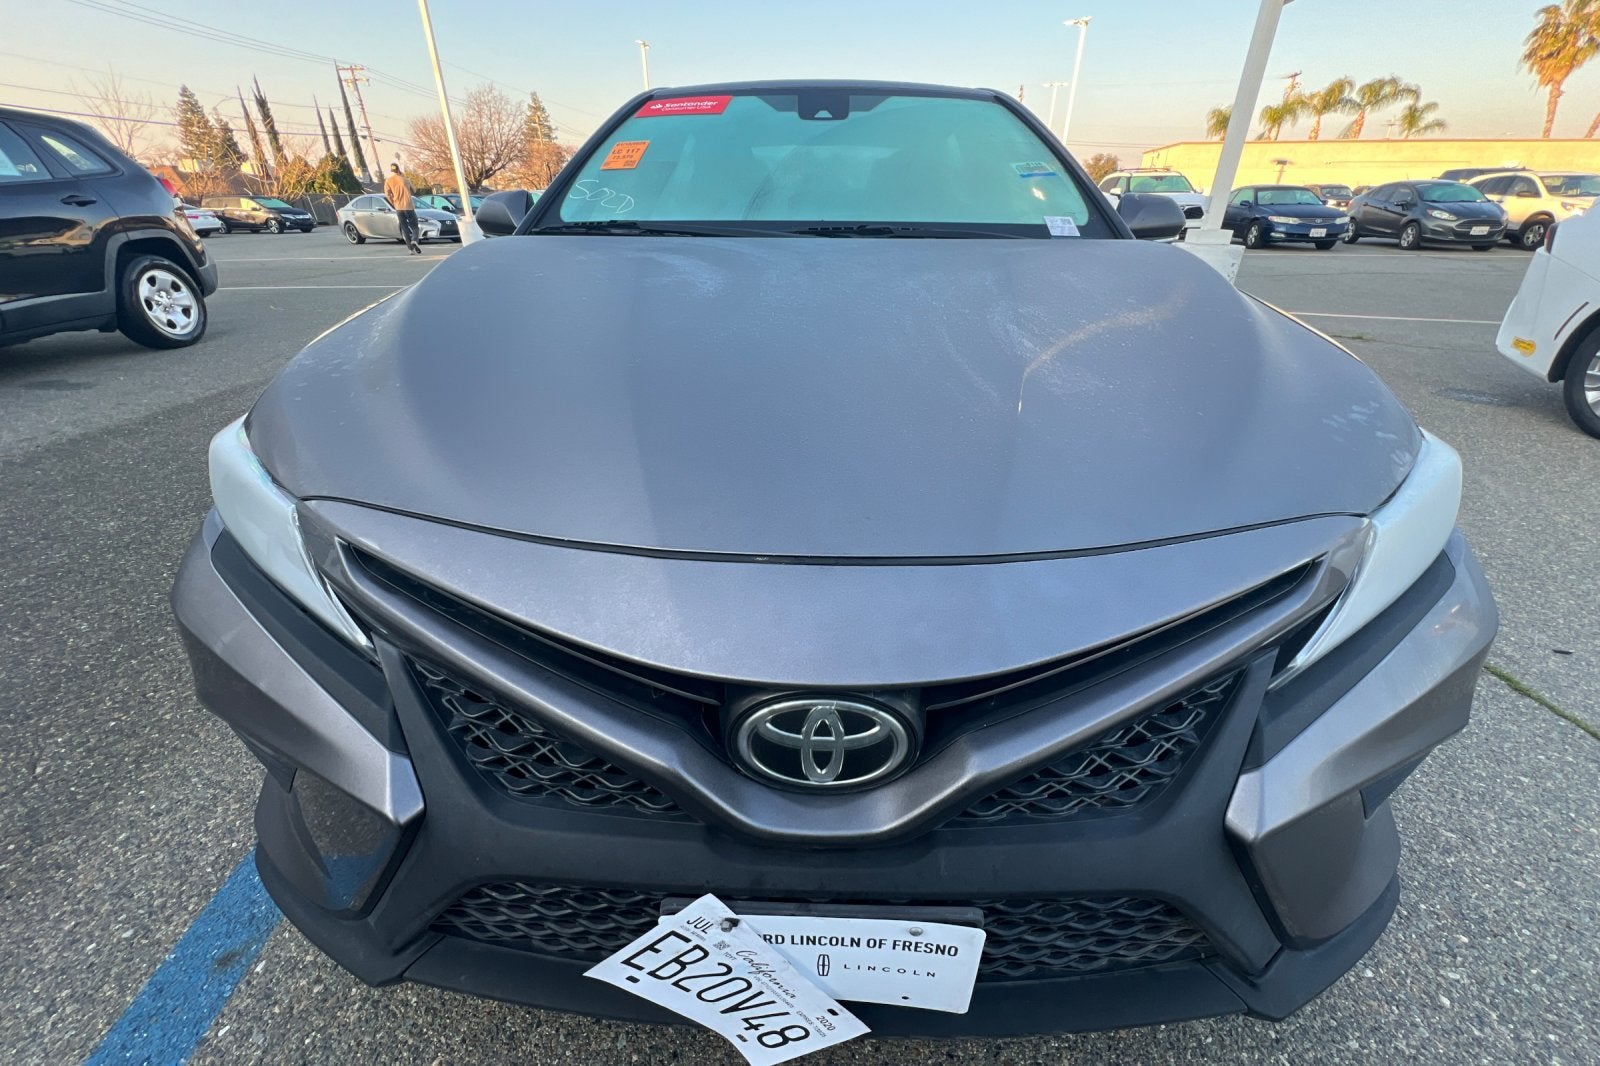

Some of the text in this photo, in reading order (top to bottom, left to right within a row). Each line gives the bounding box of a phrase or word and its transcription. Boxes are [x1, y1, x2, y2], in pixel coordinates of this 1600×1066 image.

[686, 916, 714, 935] JUL
[757, 932, 959, 957] RD LINCOLN OF FRESNO
[735, 950, 797, 1000] California
[843, 963, 936, 978] LINCOLN
[816, 1015, 836, 1032] 2020
